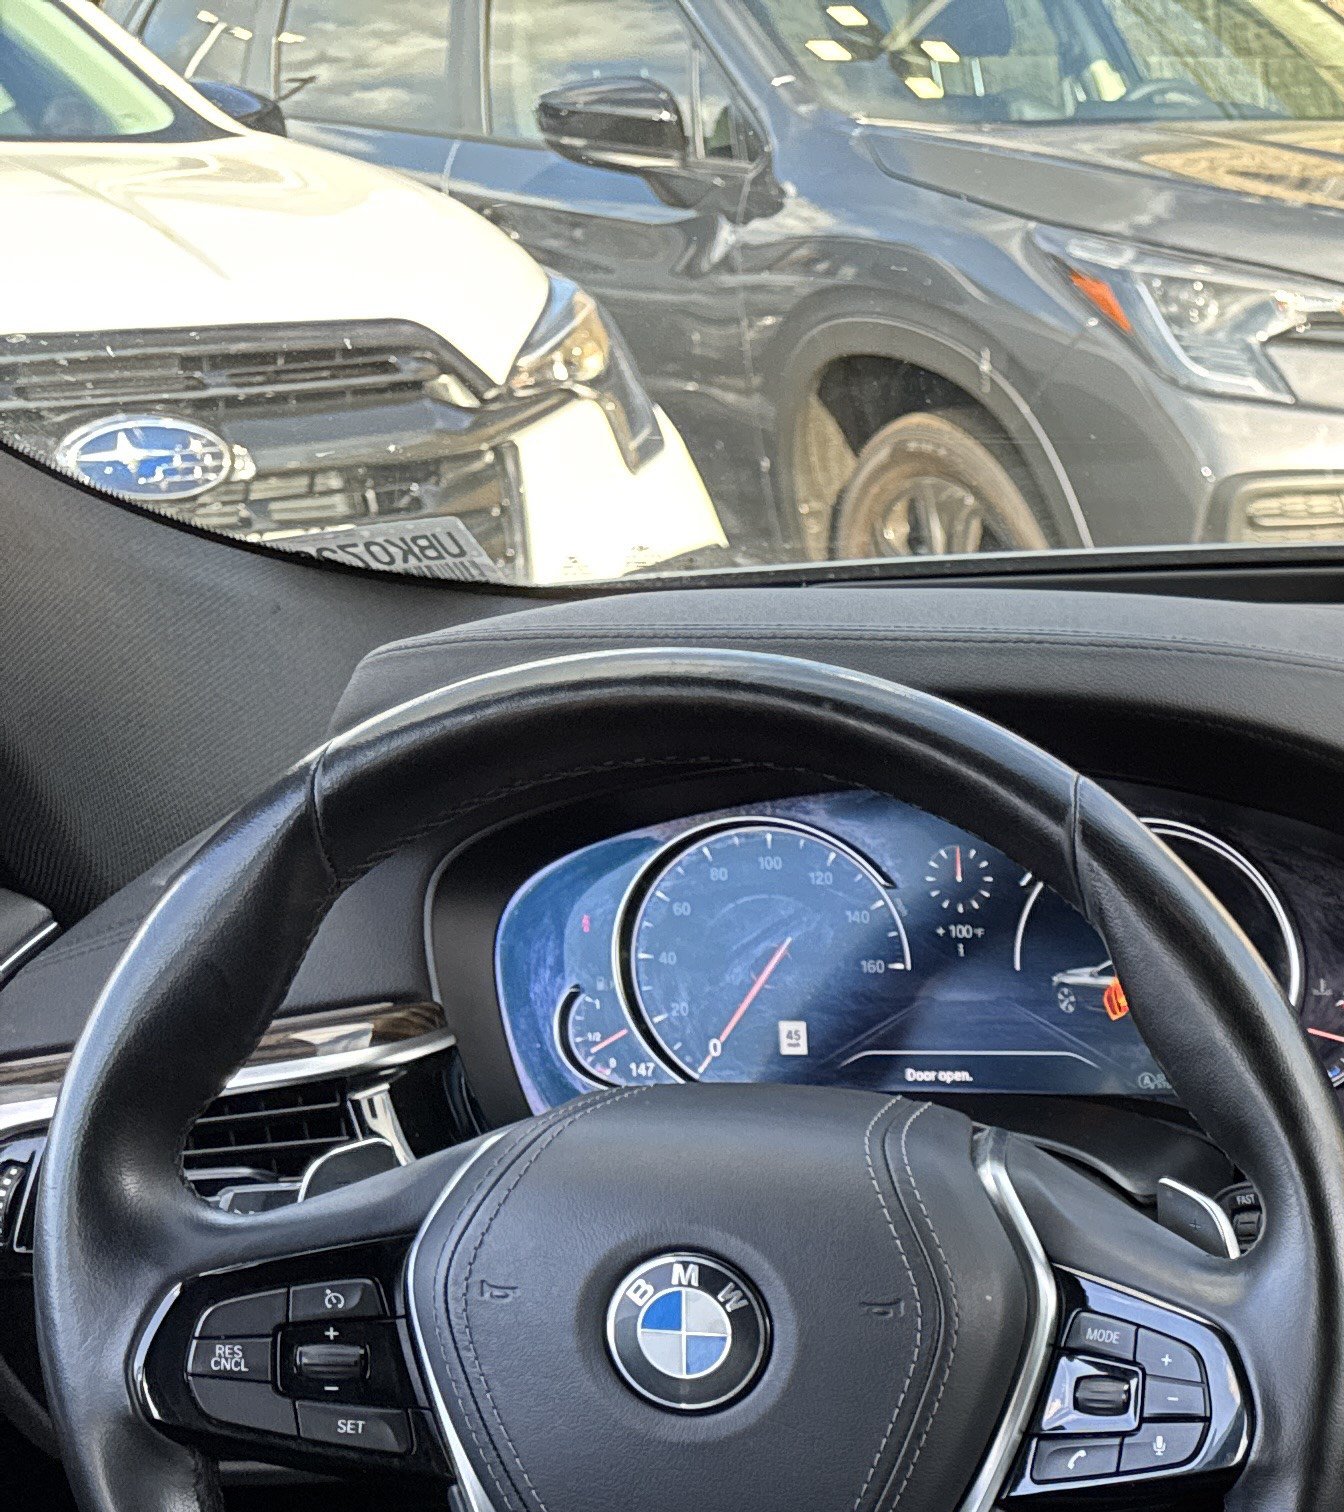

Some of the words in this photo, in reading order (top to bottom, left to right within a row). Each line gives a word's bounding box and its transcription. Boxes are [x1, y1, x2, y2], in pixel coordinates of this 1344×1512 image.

[758, 856, 782, 870] 100
[710, 868, 728, 881] 80
[809, 871, 833, 885] 120
[673, 903, 691, 917] 60
[846, 910, 870, 924] 140
[659, 951, 676, 966] 40
[861, 960, 884, 974] 160
[671, 1002, 689, 1017] 20
[785, 1028, 802, 1043] 45
[708, 1037, 722, 1056] 0
[629, 1062, 654, 1077] 147
[904, 1067, 936, 1082] Door
[626, 1262, 749, 1313] BMW
[1085, 1326, 1121, 1345] MODE
[214, 1344, 244, 1359] RES
[210, 1356, 249, 1372] CNCL
[336, 1418, 366, 1436] SET
